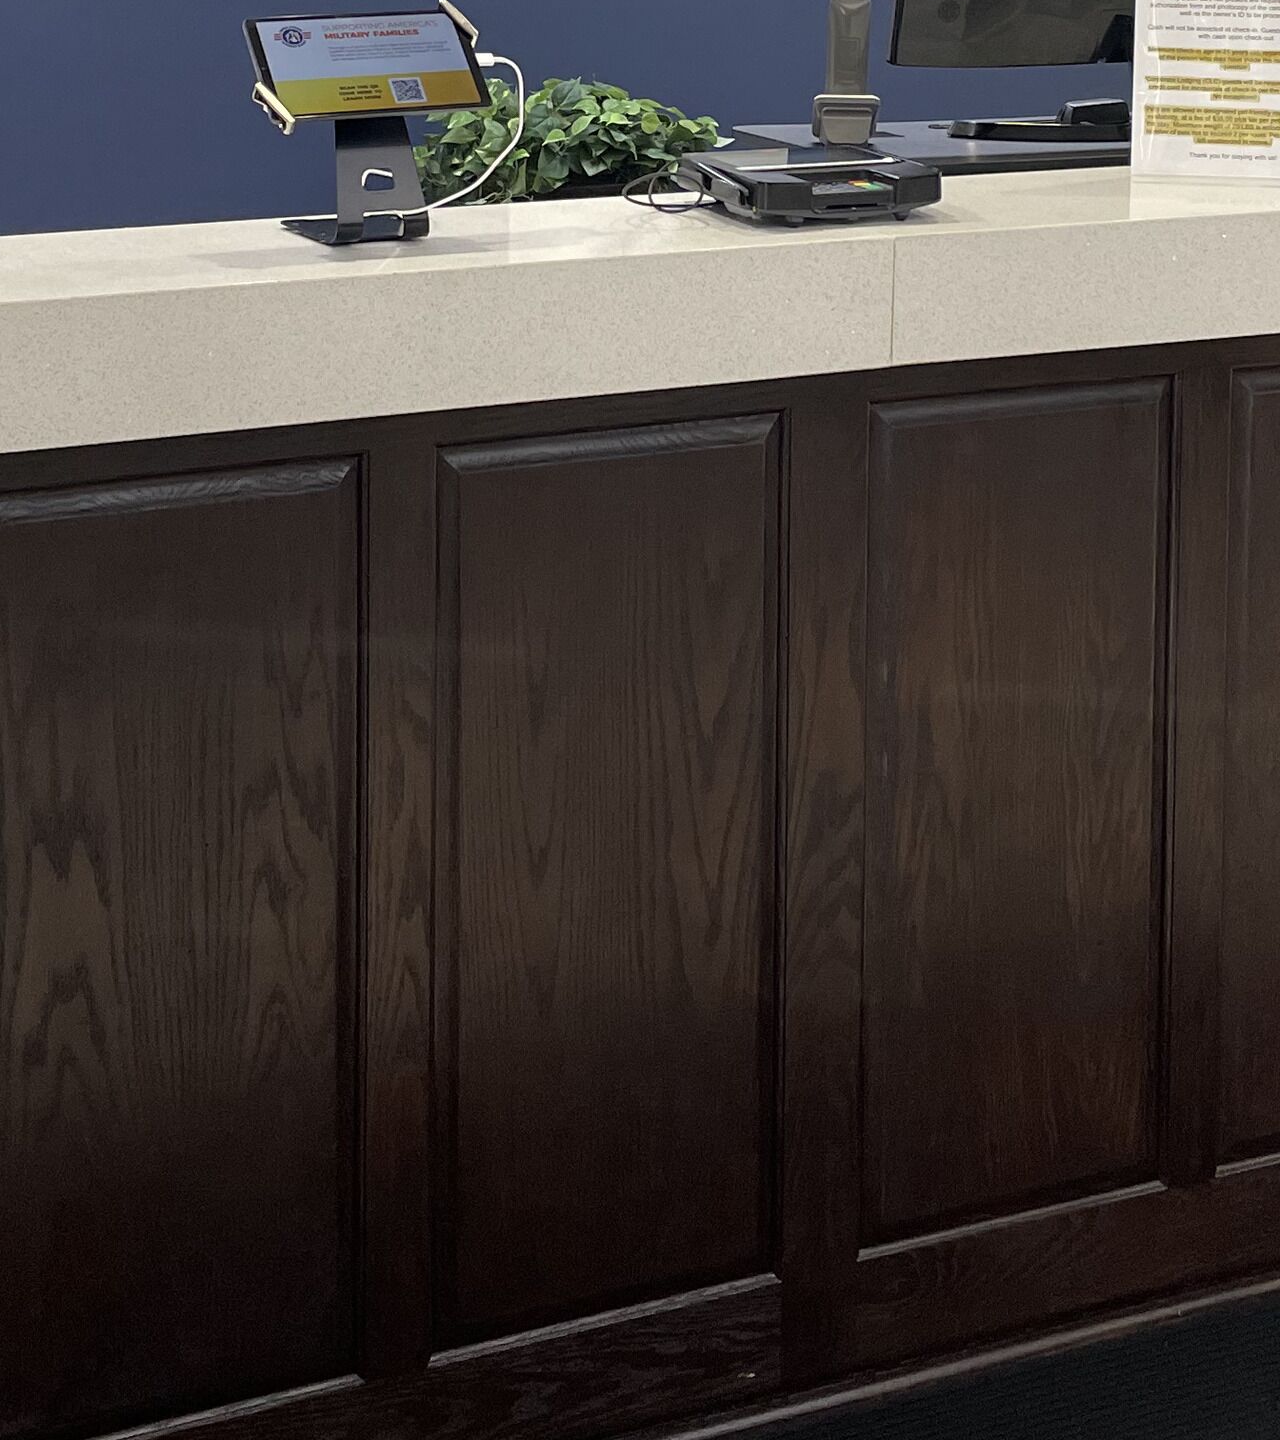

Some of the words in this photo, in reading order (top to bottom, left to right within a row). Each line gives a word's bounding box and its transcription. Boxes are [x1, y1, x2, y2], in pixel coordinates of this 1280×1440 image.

[321, 22, 385, 32] SUPPORTING
[324, 30, 370, 40] MILITARY
[373, 28, 420, 37] FAMILIES
